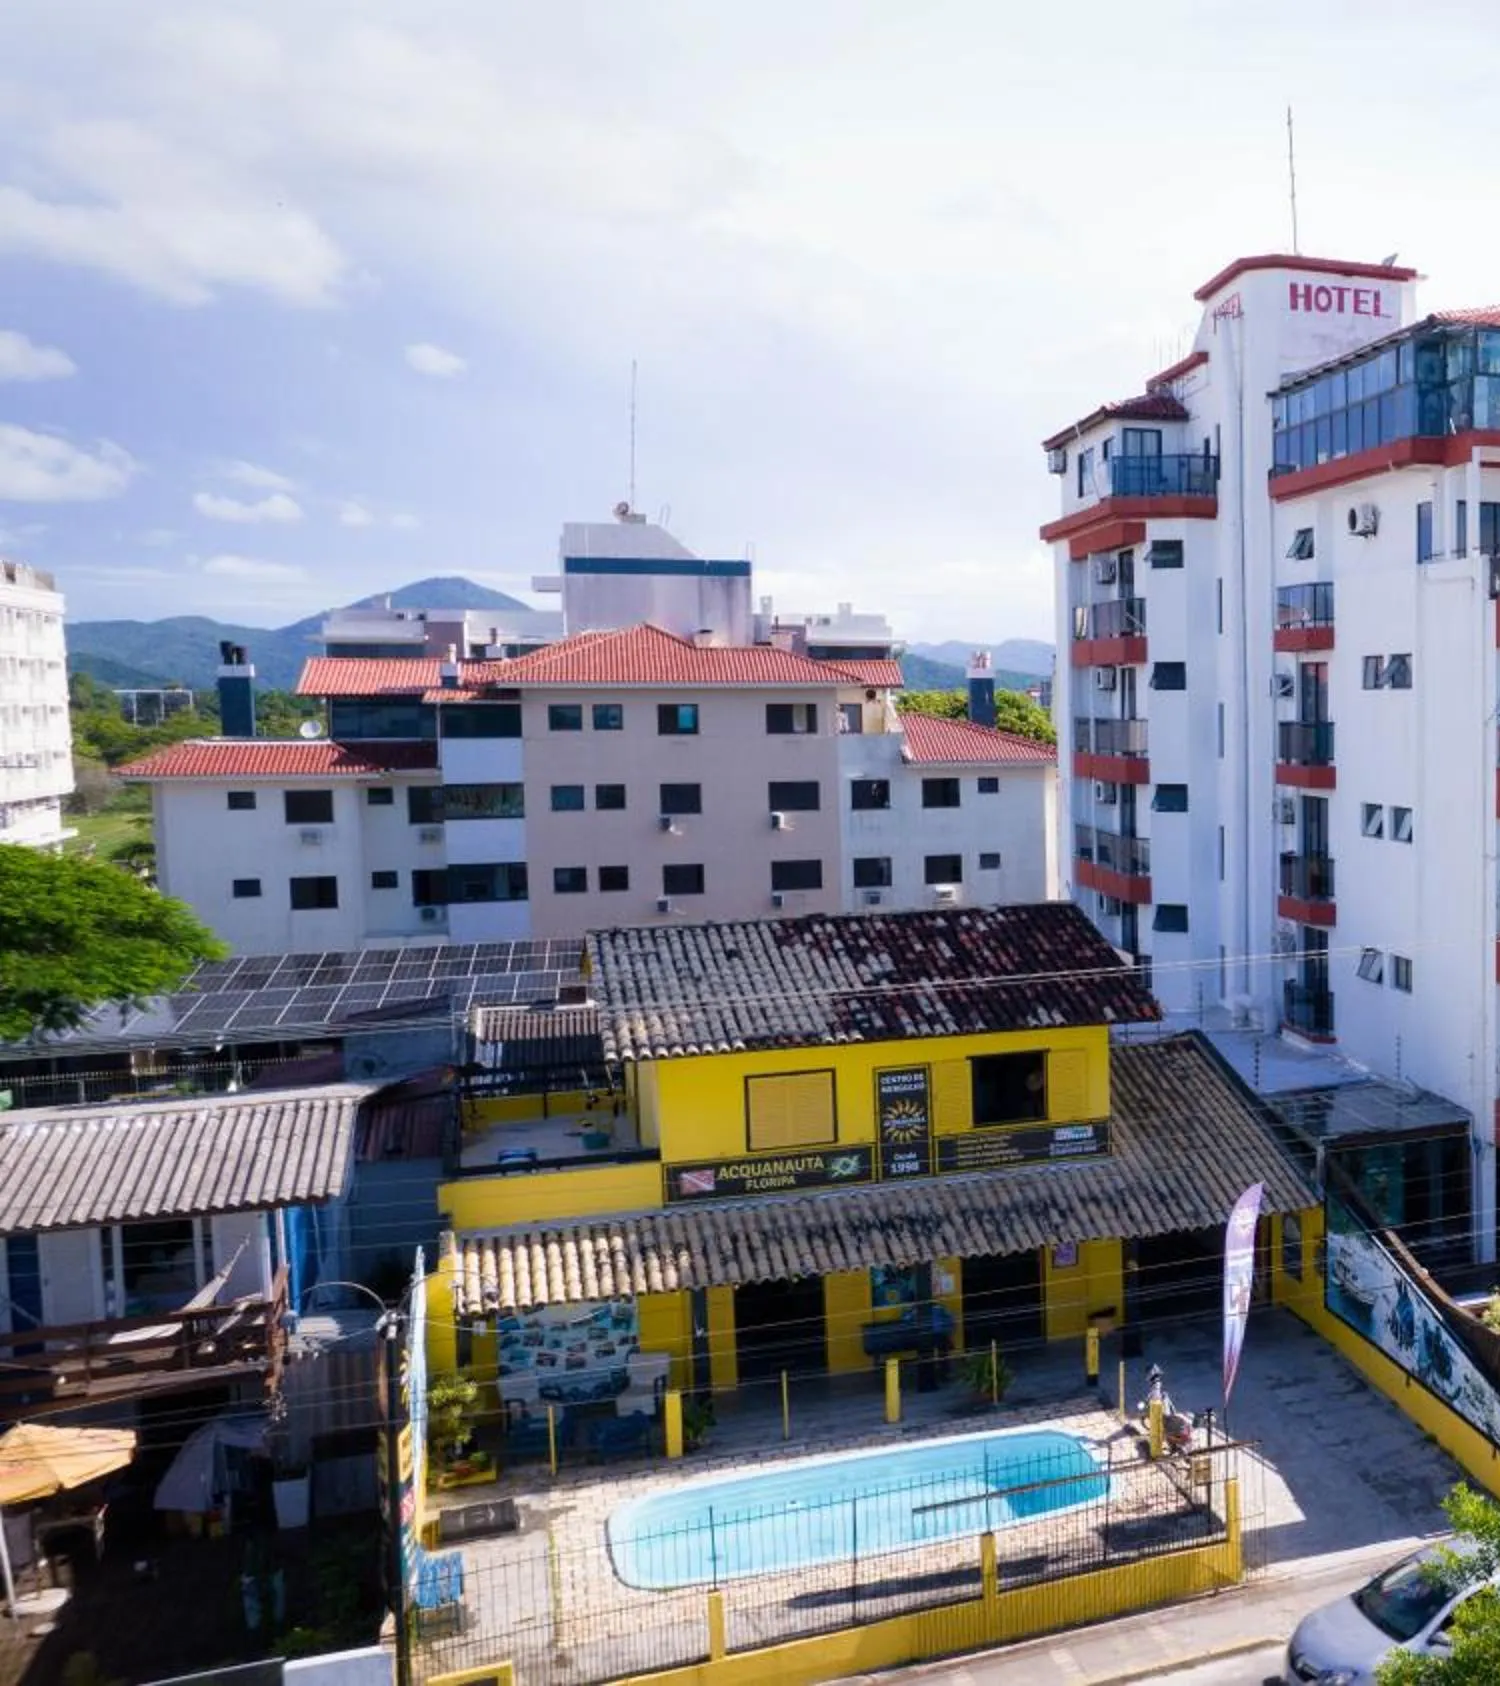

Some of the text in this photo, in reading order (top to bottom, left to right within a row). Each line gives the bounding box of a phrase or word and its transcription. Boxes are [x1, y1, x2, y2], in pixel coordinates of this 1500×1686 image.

[1289, 282, 1391, 319] HOTEL
[718, 1156, 824, 1180] ACQUANAUTA
[746, 1175, 796, 1191] FLORIPA
